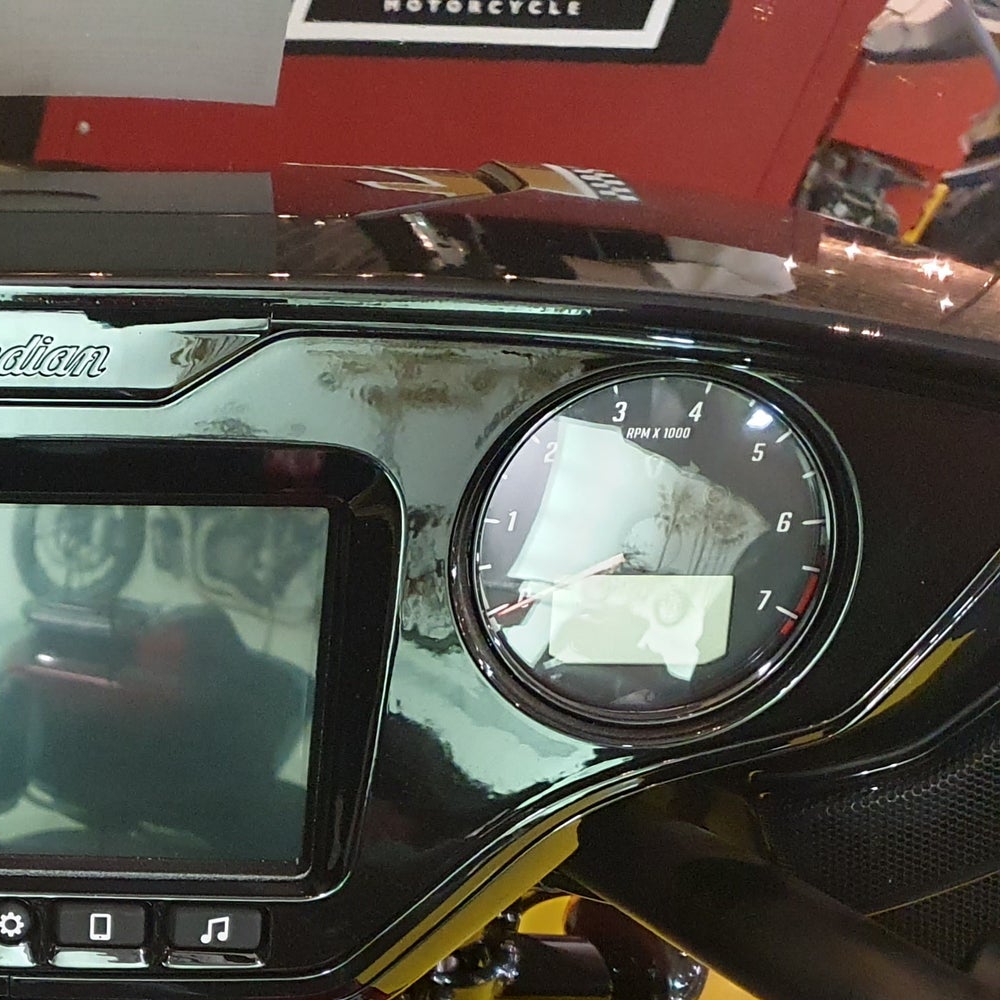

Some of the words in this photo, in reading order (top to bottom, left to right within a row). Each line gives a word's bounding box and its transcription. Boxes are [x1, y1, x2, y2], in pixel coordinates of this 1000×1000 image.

[383, 0, 582, 15] MOTORCYCLE
[612, 401, 627, 423] 3
[689, 401, 704, 422] 4
[626, 427, 653, 439] RPM
[663, 427, 691, 440] 1000
[543, 443, 557, 463] 2
[752, 443, 766, 462] 5
[507, 511, 517, 531] 1
[776, 512, 793, 533] 6
[757, 590, 772, 610] 7
